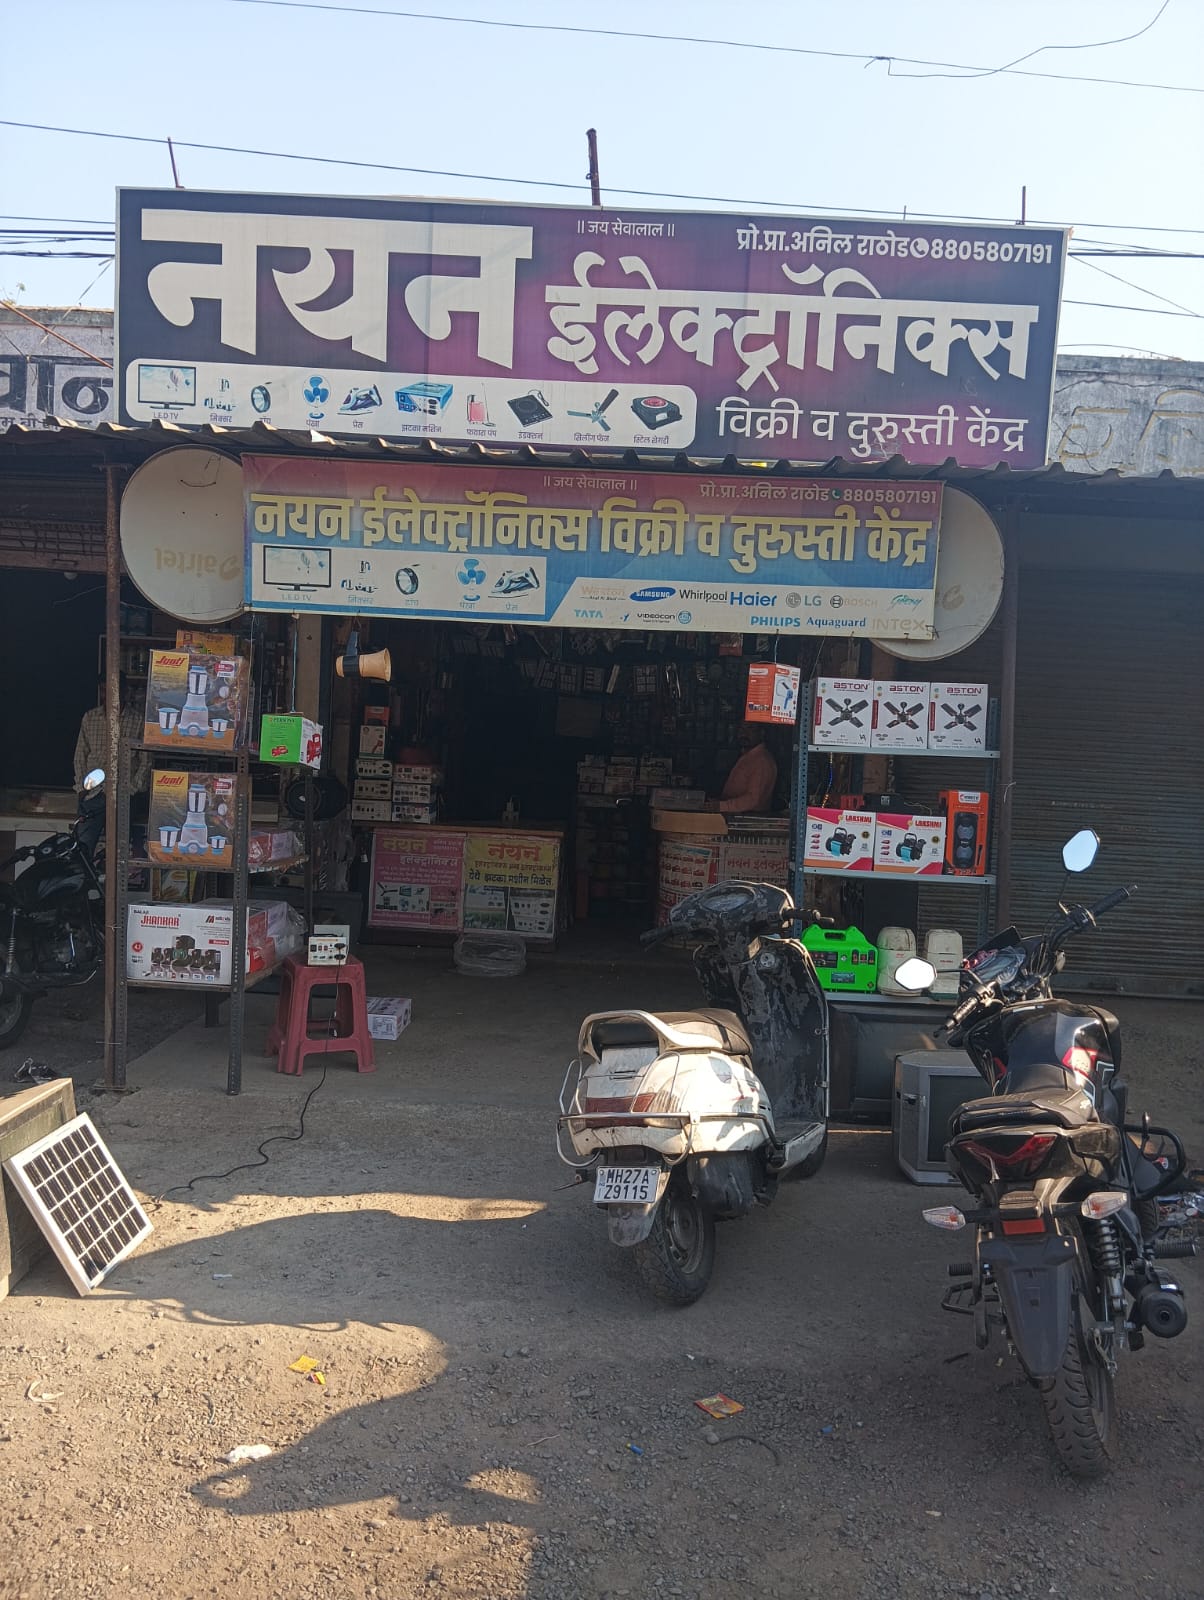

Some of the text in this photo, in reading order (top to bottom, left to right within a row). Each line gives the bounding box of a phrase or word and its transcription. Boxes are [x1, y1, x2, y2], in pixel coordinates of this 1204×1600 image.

[587, 219, 609, 235] जय
[610, 217, 664, 237] सेवालाल
[856, 233, 911, 257] राठोड
[930, 239, 1053, 265] 8805807191
[141, 208, 534, 369] नयन
[544, 251, 1040, 393] ईलेक्ट्रॉनिक्स
[716, 396, 1029, 456] विक्री व दुरुस्ती केंद्र
[552, 476, 574, 490] जय
[577, 474, 627, 491] सेवालाल
[790, 484, 830, 502] राठोड
[843, 488, 937, 505] 8805807191
[251, 486, 934, 574] नयन ईलेक्ट्रॉनिक्स विक्री व दुरुस्ती केंद्र
[636, 590, 671, 599] SAMSUNG
[679, 589, 728, 603] Whirlpool
[730, 591, 777, 607] Haier
[804, 595, 822, 607] LG
[574, 609, 603, 618] TATA
[750, 616, 801, 628] PHILIPS
[806, 616, 867, 629] Aquaguard
[488, 843, 541, 862] नयन
[606, 1169, 649, 1184] MH27A
[603, 1185, 649, 1200] Z9115
